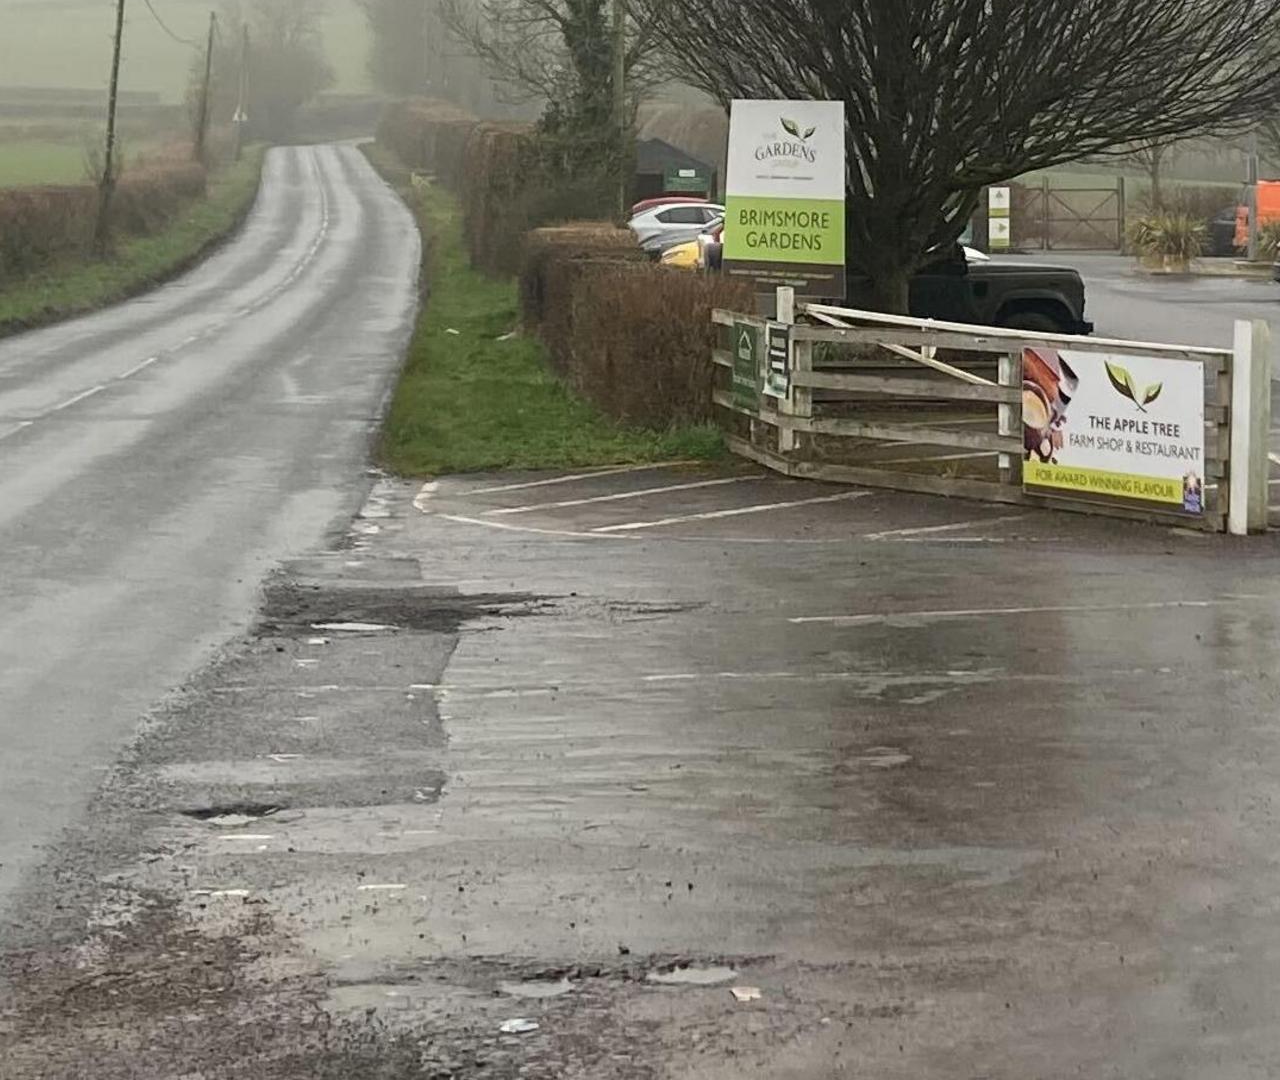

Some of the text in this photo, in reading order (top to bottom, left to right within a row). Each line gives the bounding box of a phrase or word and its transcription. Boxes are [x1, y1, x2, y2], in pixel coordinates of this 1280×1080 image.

[755, 142, 816, 163] GARDENS
[739, 209, 830, 229] BRIMSMORE
[746, 231, 822, 250] GARDENS
[1089, 415, 1181, 438] THE APPLE TREE
[1069, 433, 1201, 460] FARM SHOP & RESTAURANT
[1035, 469, 1175, 498] FOR AWARD WINNING FLAVOUR
